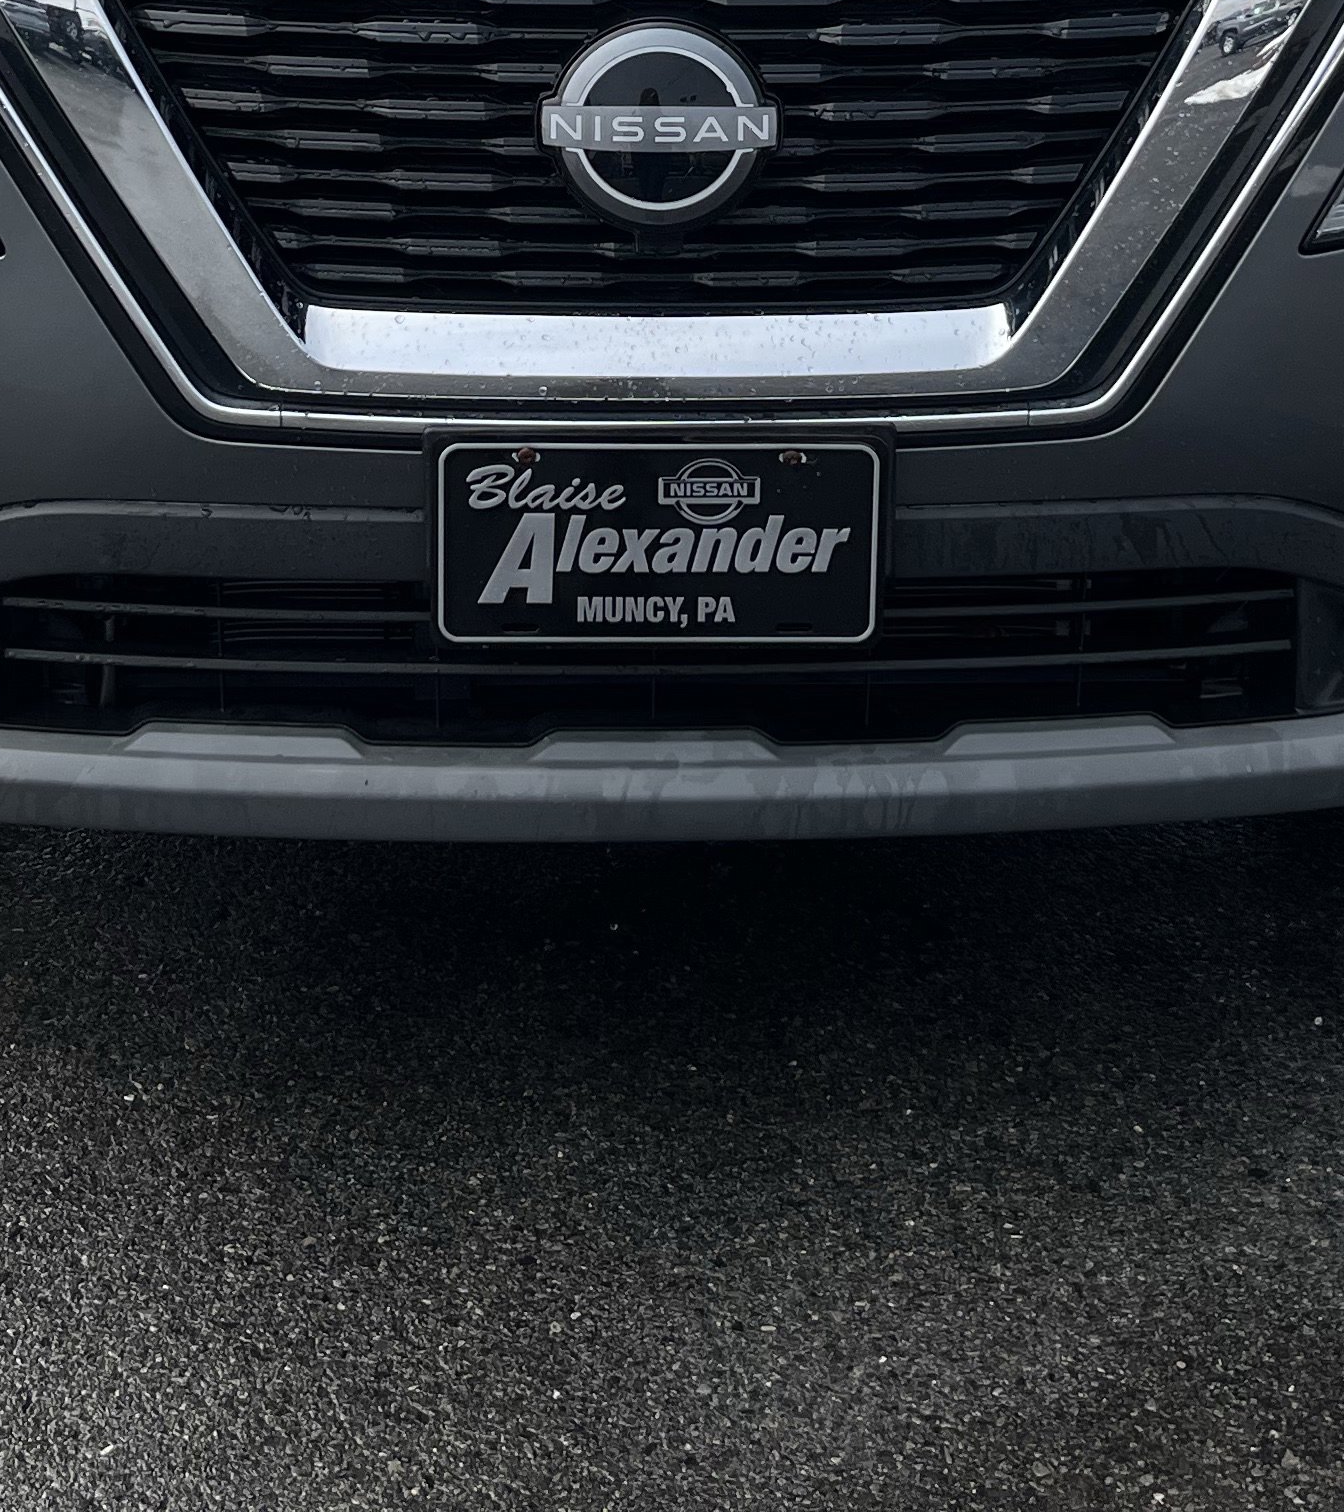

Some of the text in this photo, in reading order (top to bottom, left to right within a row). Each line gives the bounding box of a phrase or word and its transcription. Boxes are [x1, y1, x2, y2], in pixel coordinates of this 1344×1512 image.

[550, 113, 771, 143] NISSAN
[466, 464, 626, 510] Blaise
[669, 481, 749, 497] NISSAN
[477, 513, 850, 605] Alexander
[576, 596, 735, 627] MUNCY, PA
